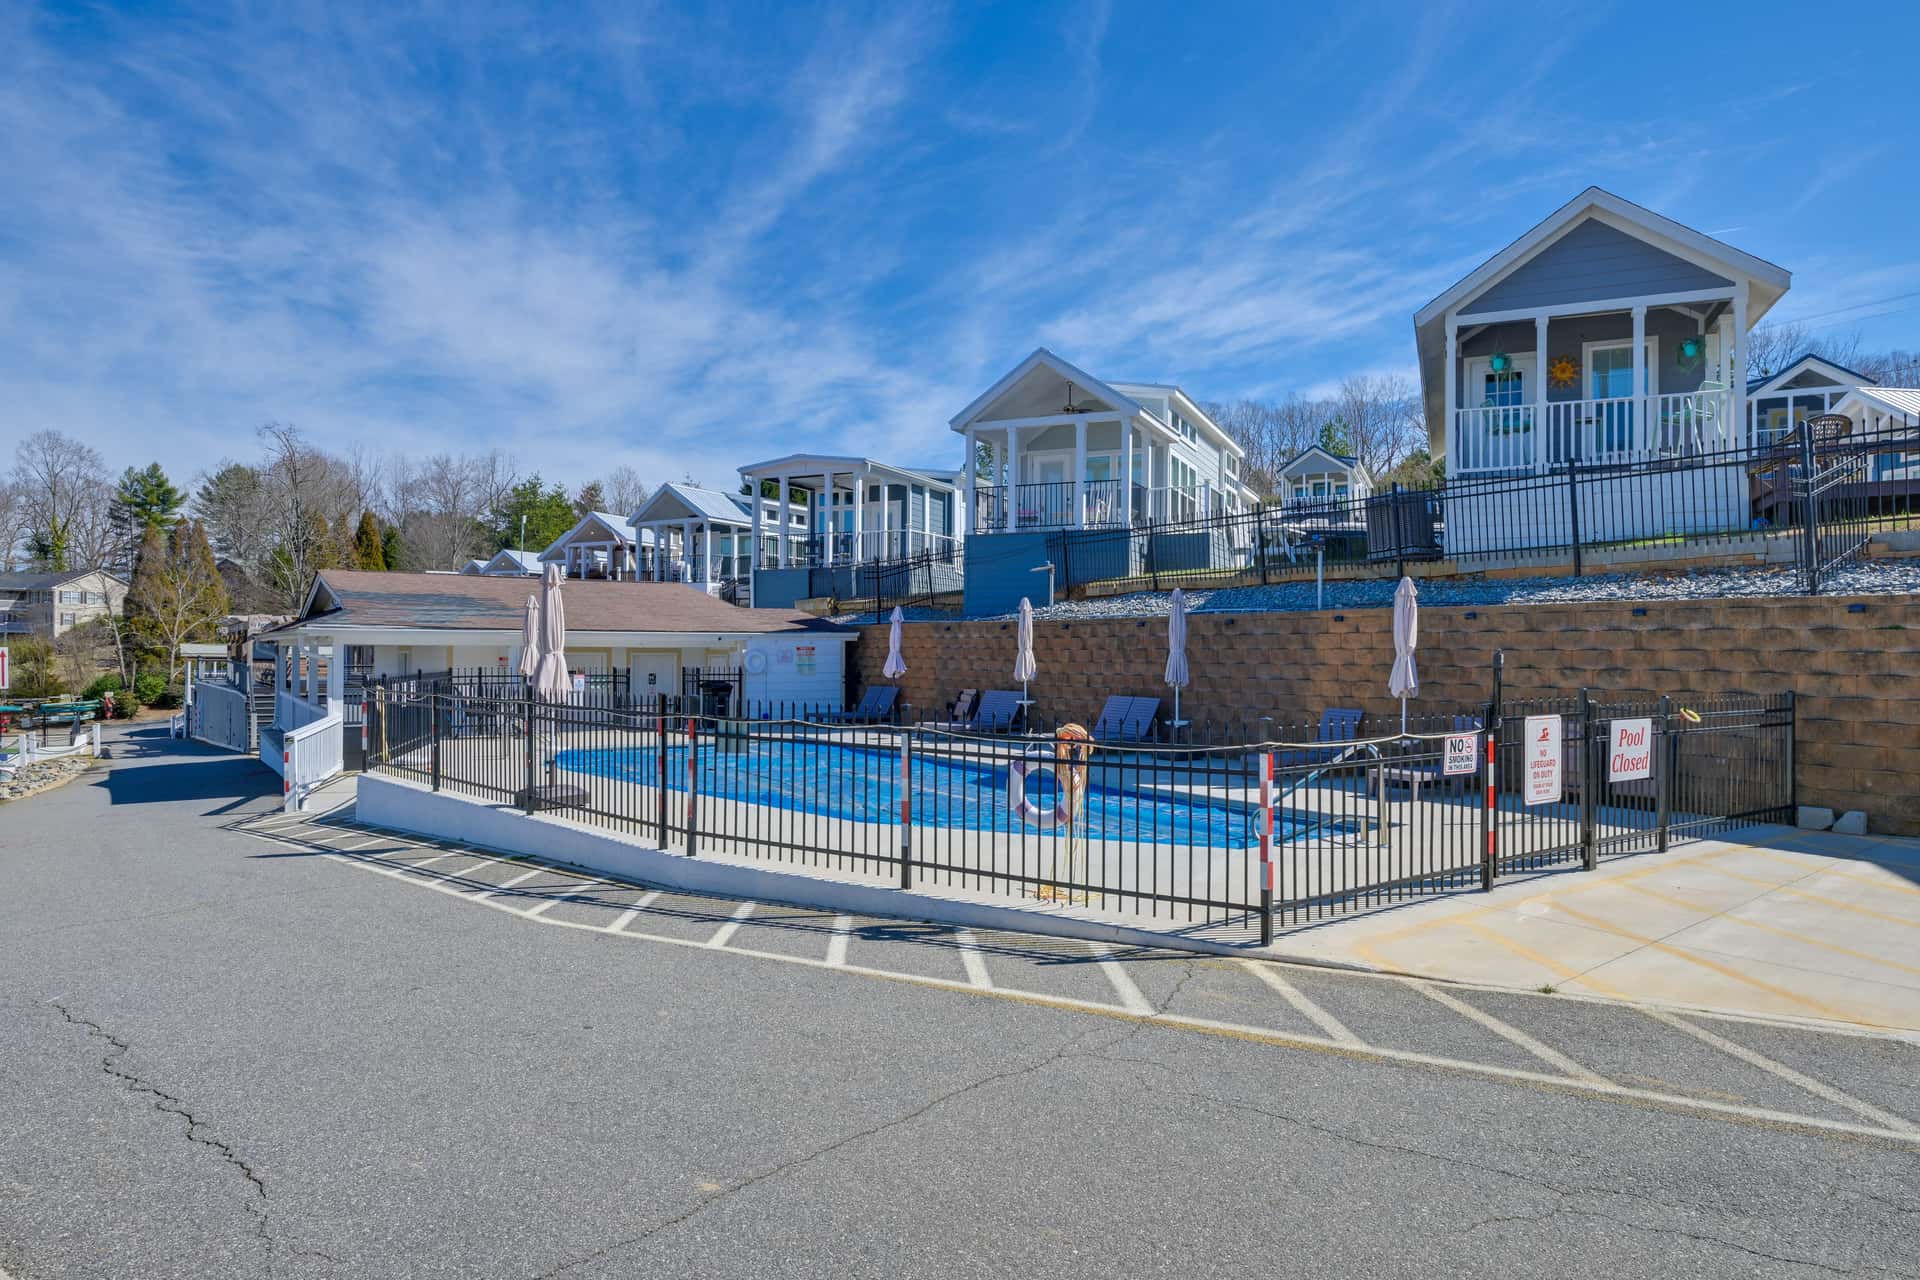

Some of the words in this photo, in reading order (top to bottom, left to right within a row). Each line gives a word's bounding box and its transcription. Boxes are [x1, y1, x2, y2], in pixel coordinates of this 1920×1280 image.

[1619, 726, 1645, 747] Pool
[1450, 739, 1464, 753] NO
[1448, 754, 1473, 764] SMOKING
[1530, 759, 1556, 769] LIFEGUARD
[1612, 751, 1649, 773] Closed
[1533, 771, 1541, 779] ON
[1541, 770, 1552, 778] DUTY
